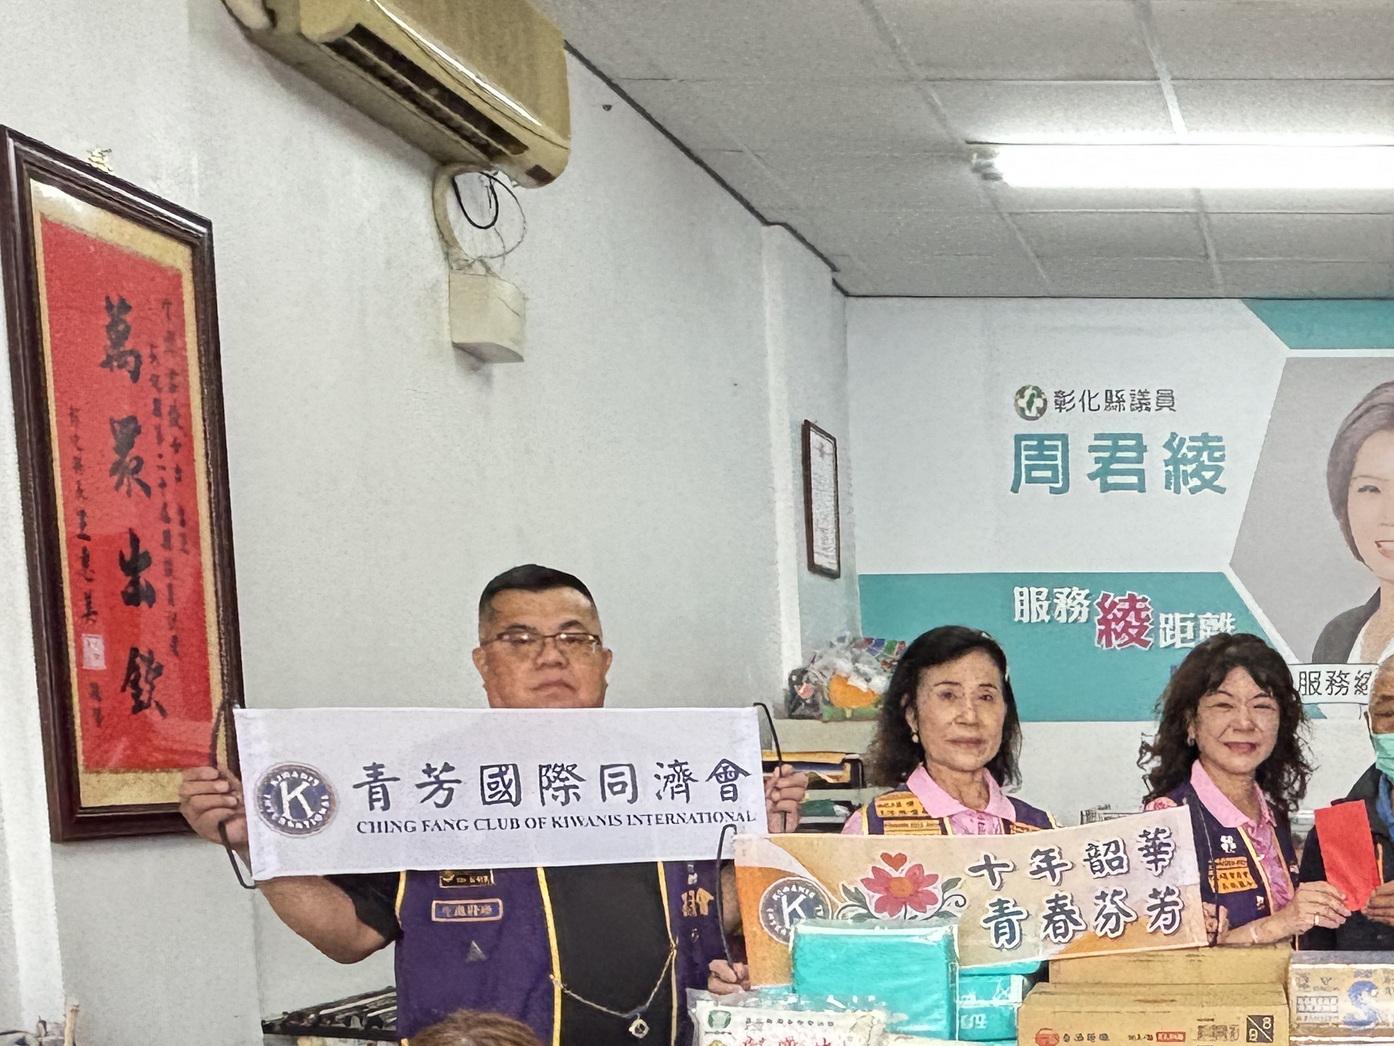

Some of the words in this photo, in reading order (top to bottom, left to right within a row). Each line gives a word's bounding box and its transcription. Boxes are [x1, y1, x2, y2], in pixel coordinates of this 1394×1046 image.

[1053, 388, 1177, 413] 彰化縣議員
[1010, 431, 1227, 495] 周君綾
[279, 780, 316, 820] K
[352, 758, 752, 811] 青芳國際同濟會
[356, 820, 417, 834] CHING
[422, 819, 469, 833] FANG
[474, 817, 521, 831] CLUB
[525, 817, 547, 830] OF
[552, 814, 623, 829] KIWANIS
[627, 810, 756, 826] INTERNATIONAL
[967, 827, 1174, 889] 十年韶華
[982, 886, 1183, 949] 青春芬芳
